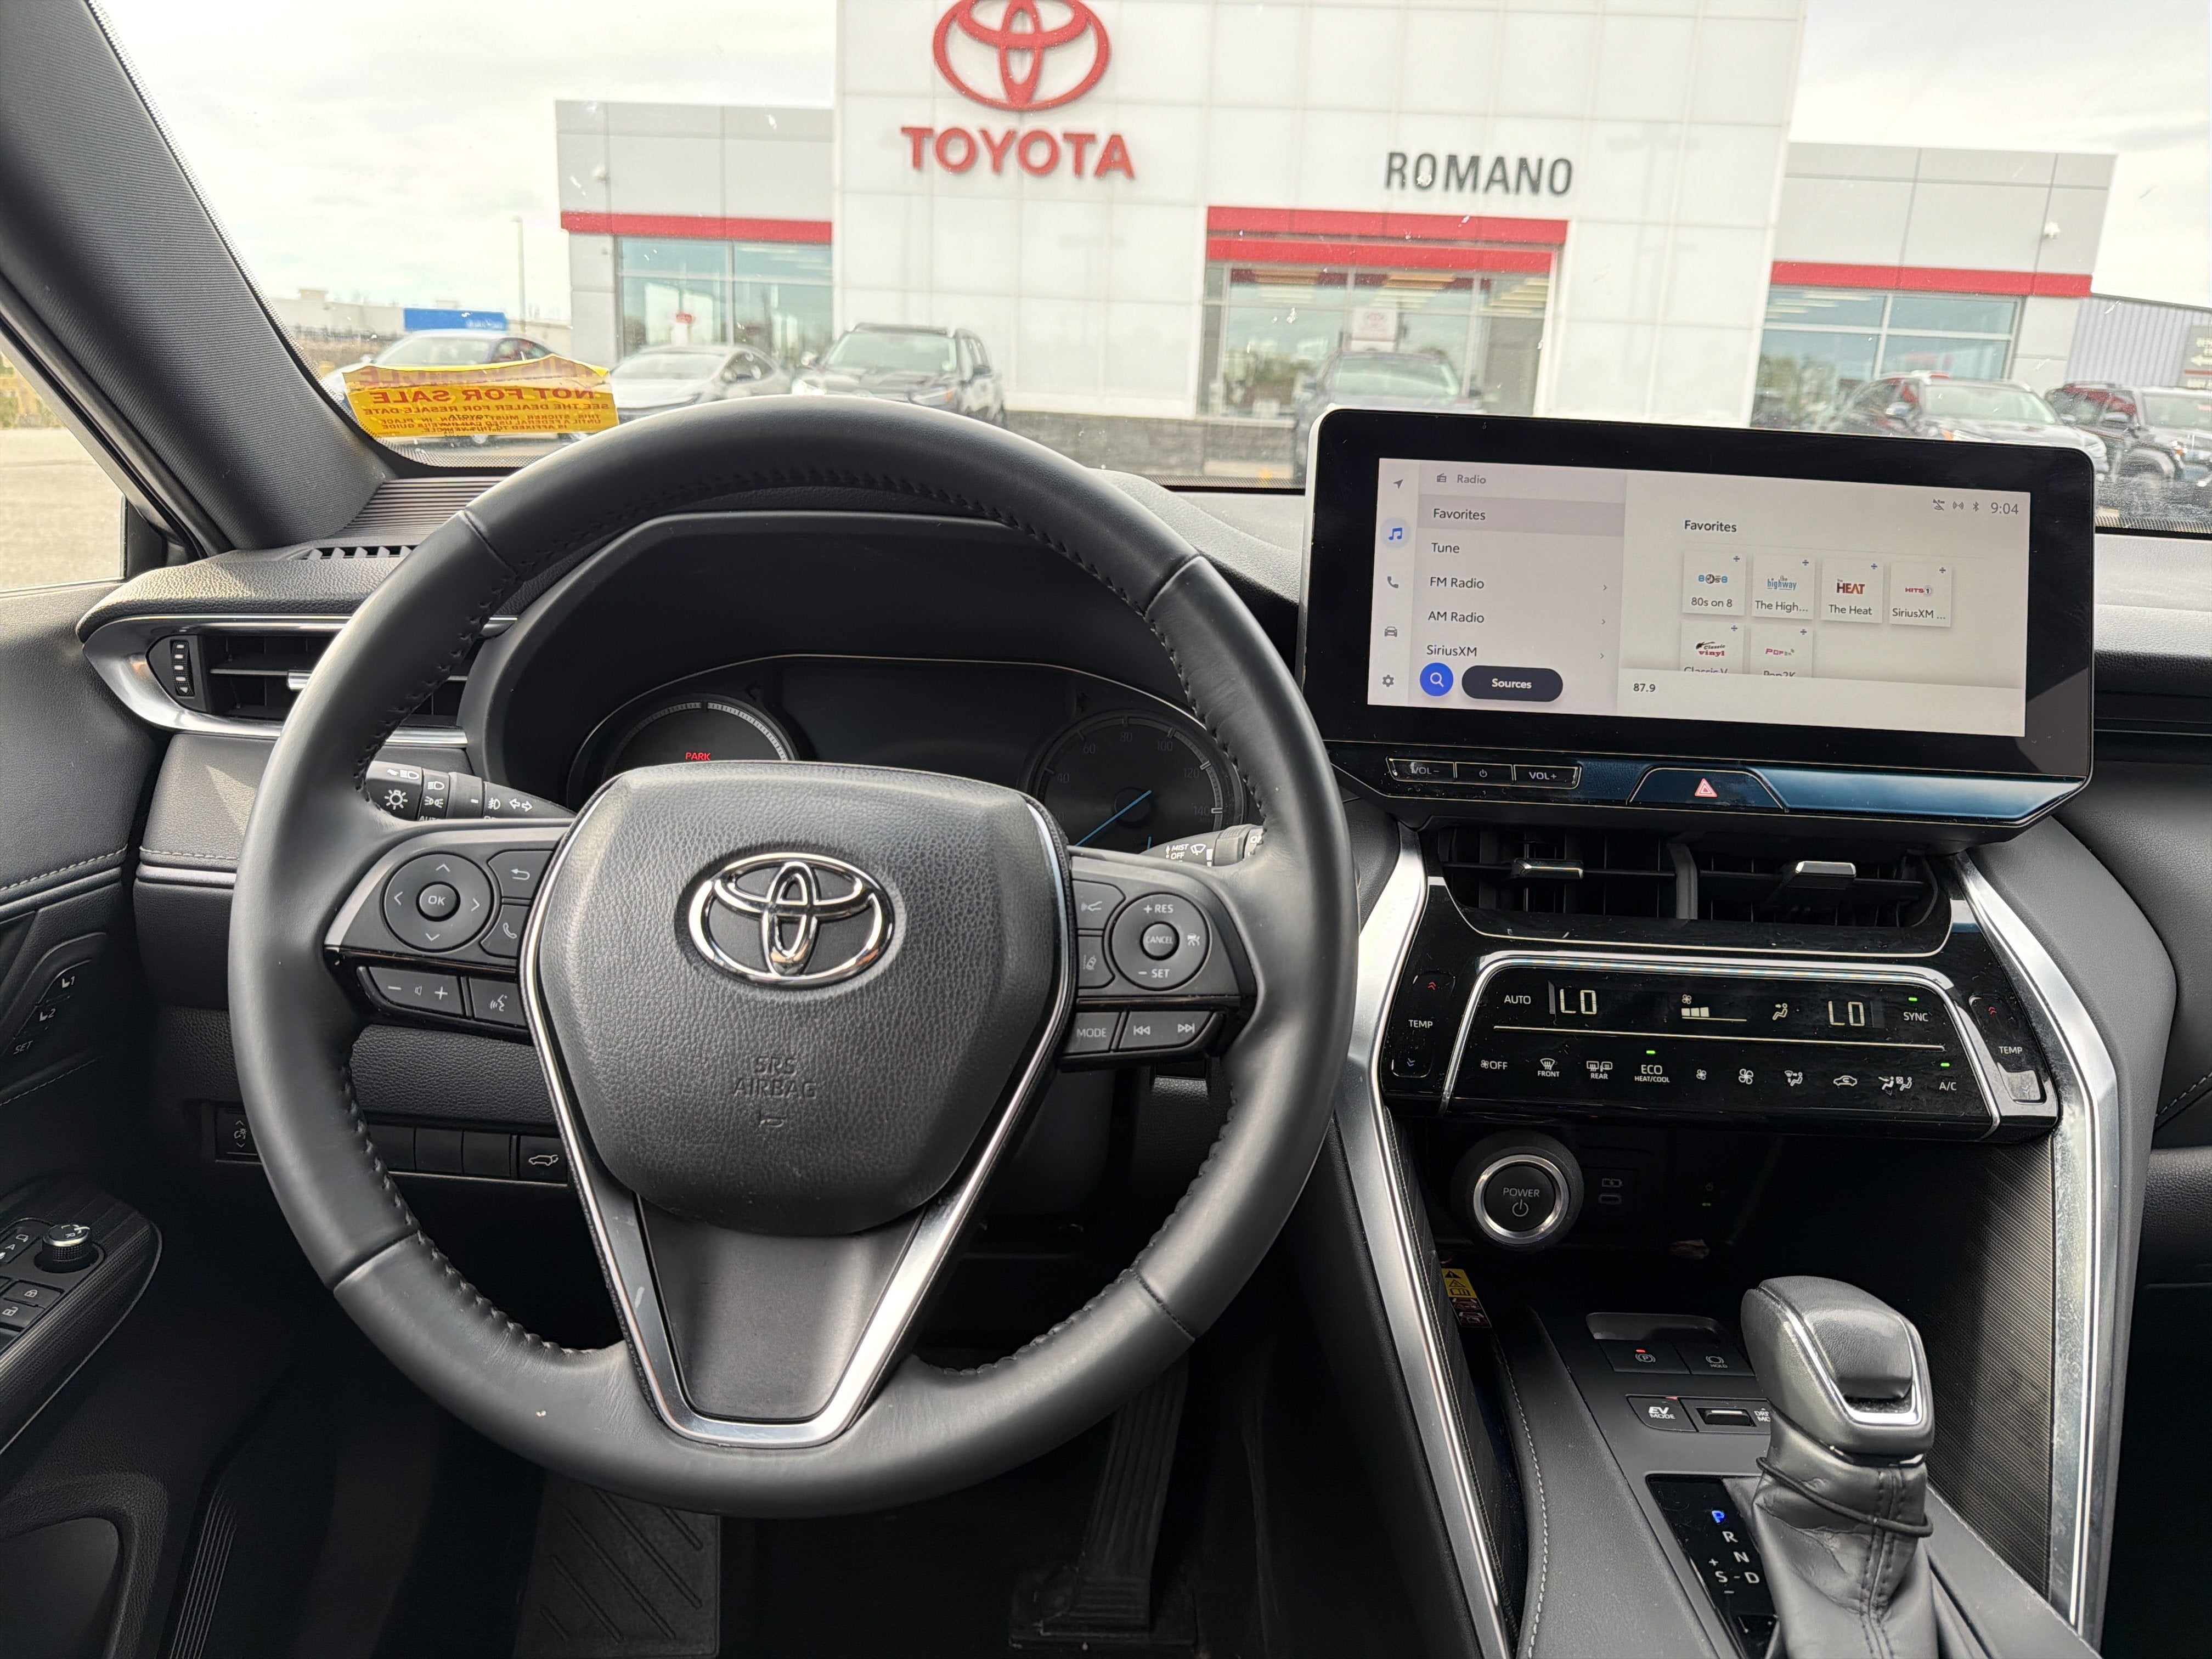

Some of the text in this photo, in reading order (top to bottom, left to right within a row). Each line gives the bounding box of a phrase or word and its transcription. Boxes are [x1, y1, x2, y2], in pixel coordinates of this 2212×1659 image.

[900, 127, 1135, 179] TOYOTA
[1384, 151, 1572, 195] ROMANO
[1457, 474, 1486, 484] Radio
[1990, 502, 2019, 514] 9:04
[1434, 508, 1486, 521] Favorites
[1684, 520, 1737, 532] Favorites
[1431, 542, 1460, 554] Tune
[1430, 577, 1485, 589] FM Radio
[1767, 578, 1797, 591] highway
[1836, 582, 1865, 594] HEAT
[1691, 597, 1708, 607] 80s
[1726, 599, 1733, 607] 8
[1755, 600, 1773, 610] The
[1829, 604, 1872, 615] The Heat
[1892, 608, 1934, 619] SiriusXM
[1428, 611, 1485, 623] AM Radio
[1426, 645, 1477, 657] SiriusXM
[1491, 678, 1532, 689] Sources
[1633, 683, 1656, 692] 87.9
[1120, 732, 1133, 743] 80
[1082, 744, 1096, 755] 60
[685, 752, 711, 761] PARK
[1057, 773, 1070, 783] 40
[1171, 843, 1190, 851] MIST
[1170, 851, 1185, 860] OFF
[428, 895, 446, 906] OK
[1145, 935, 1173, 945] CANCEL
[1504, 995, 1531, 1005] AUTO
[1559, 988, 1598, 1015] LO
[1827, 1000, 1865, 1026] LO
[1903, 1011, 1929, 1022] SYNC
[1408, 1019, 1433, 1029] TEMP
[1076, 1028, 1107, 1038] MODE
[13, 1040, 33, 1055] SET
[1999, 1046, 2023, 1055] TEMP
[755, 1056, 797, 1076] SRS
[1489, 1060, 1508, 1070] OFF
[1641, 1064, 1663, 1075] ECO
[1590, 1072, 1609, 1080] REAR
[1634, 1075, 1671, 1084] HEAT/COOL
[733, 1077, 817, 1100] AIRBAG
[1938, 1081, 1957, 1092] A/C
[1503, 1187, 1540, 1198] POWER
[1648, 1406, 1669, 1414] EV
[1711, 1510, 1726, 1523] P
[1722, 1531, 1738, 1543] R
[1733, 1551, 1750, 1563] N
[1714, 1571, 1728, 1583] S
[1744, 1572, 1760, 1584] D
